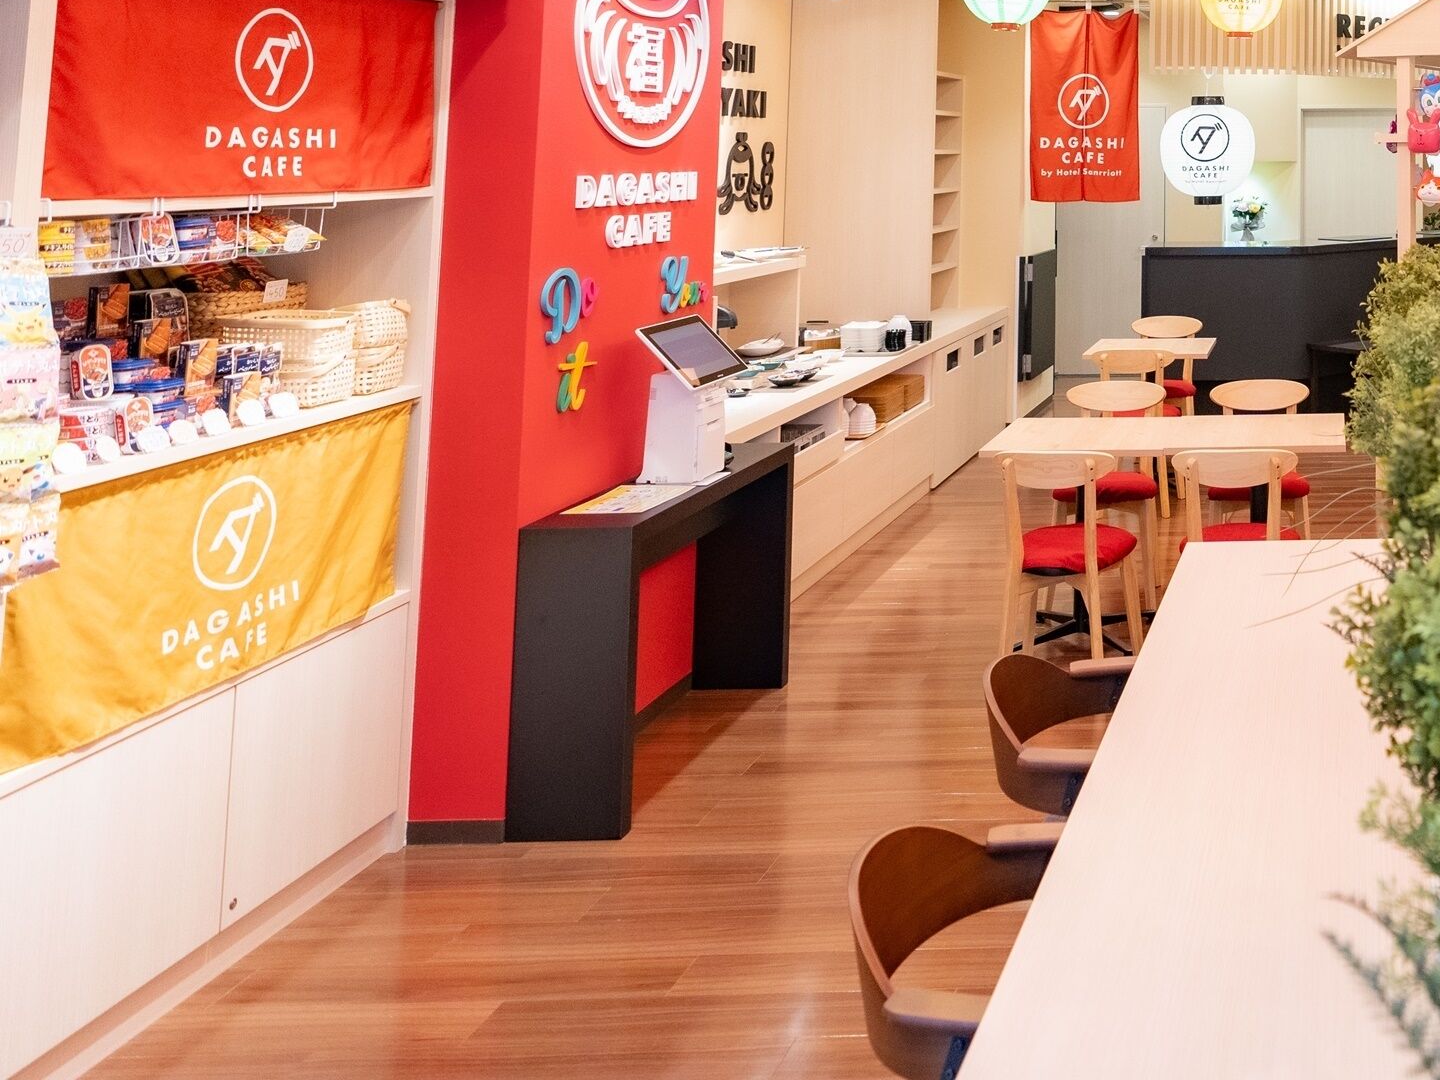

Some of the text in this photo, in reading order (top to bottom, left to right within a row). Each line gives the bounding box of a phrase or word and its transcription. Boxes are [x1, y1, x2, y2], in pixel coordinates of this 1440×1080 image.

[204, 125, 337, 149] DAGASHI
[1039, 136, 1125, 150] DAGASHI
[242, 155, 303, 178] CAFE
[1041, 168, 1122, 178] by Hotel Sanrriott
[1061, 151, 1105, 164] CAFE
[575, 171, 698, 209] DAGASHI
[604, 211, 673, 249] CAFE
[540, 255, 709, 344] Do Your
[556, 341, 598, 413] it
[161, 579, 300, 656] DAGASHI
[195, 621, 268, 671] CAFE
